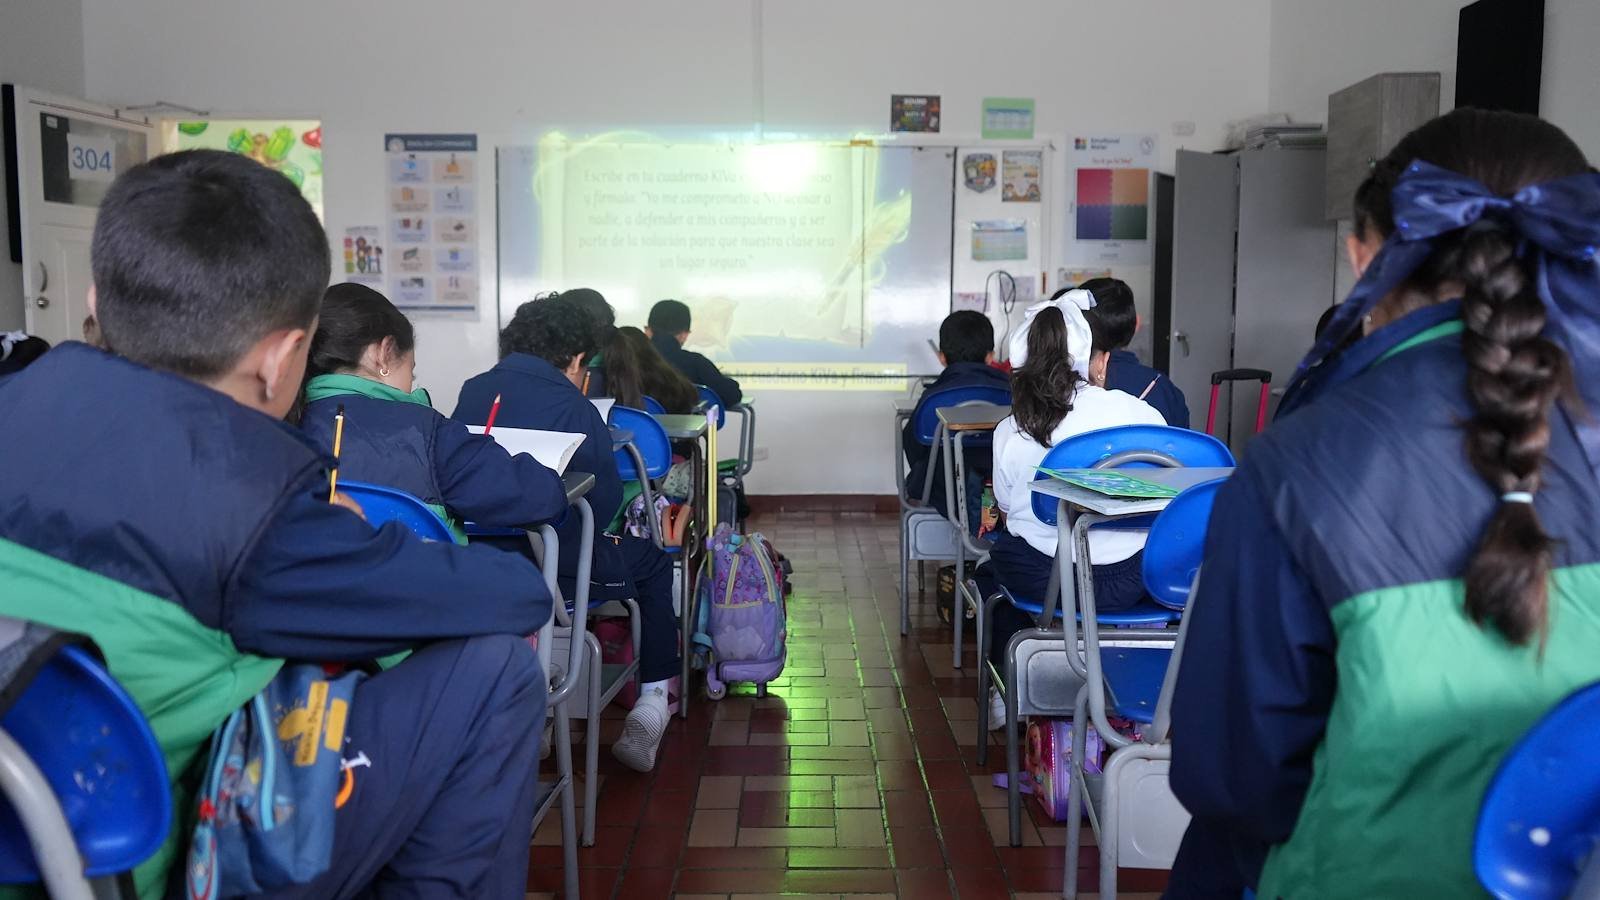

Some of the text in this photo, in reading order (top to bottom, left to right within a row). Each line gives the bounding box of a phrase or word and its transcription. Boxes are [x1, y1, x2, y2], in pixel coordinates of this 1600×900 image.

[73, 146, 112, 172] 304
[584, 169, 622, 182] Escribe
[626, 173, 640, 182] en
[642, 170, 654, 182] tu
[656, 168, 708, 182] cuaderno
[711, 169, 736, 182] KiVa
[662, 194, 678, 203] me
[681, 193, 750, 208] comprometo
[824, 194, 831, 205] a
[624, 215, 632, 225] a
[635, 210, 684, 229] defender
[686, 215, 694, 225] a
[697, 212, 716, 225] mis
[719, 212, 786, 229] compañeros
[789, 216, 797, 228] y
[799, 216, 807, 225] a
[810, 216, 825, 225] ser
[579, 232, 835, 250] parte de la solución para que nuestra clase sea
[660, 258, 673, 268] un
[676, 254, 705, 271] lugar
[752, 368, 806, 384] cuaderno
